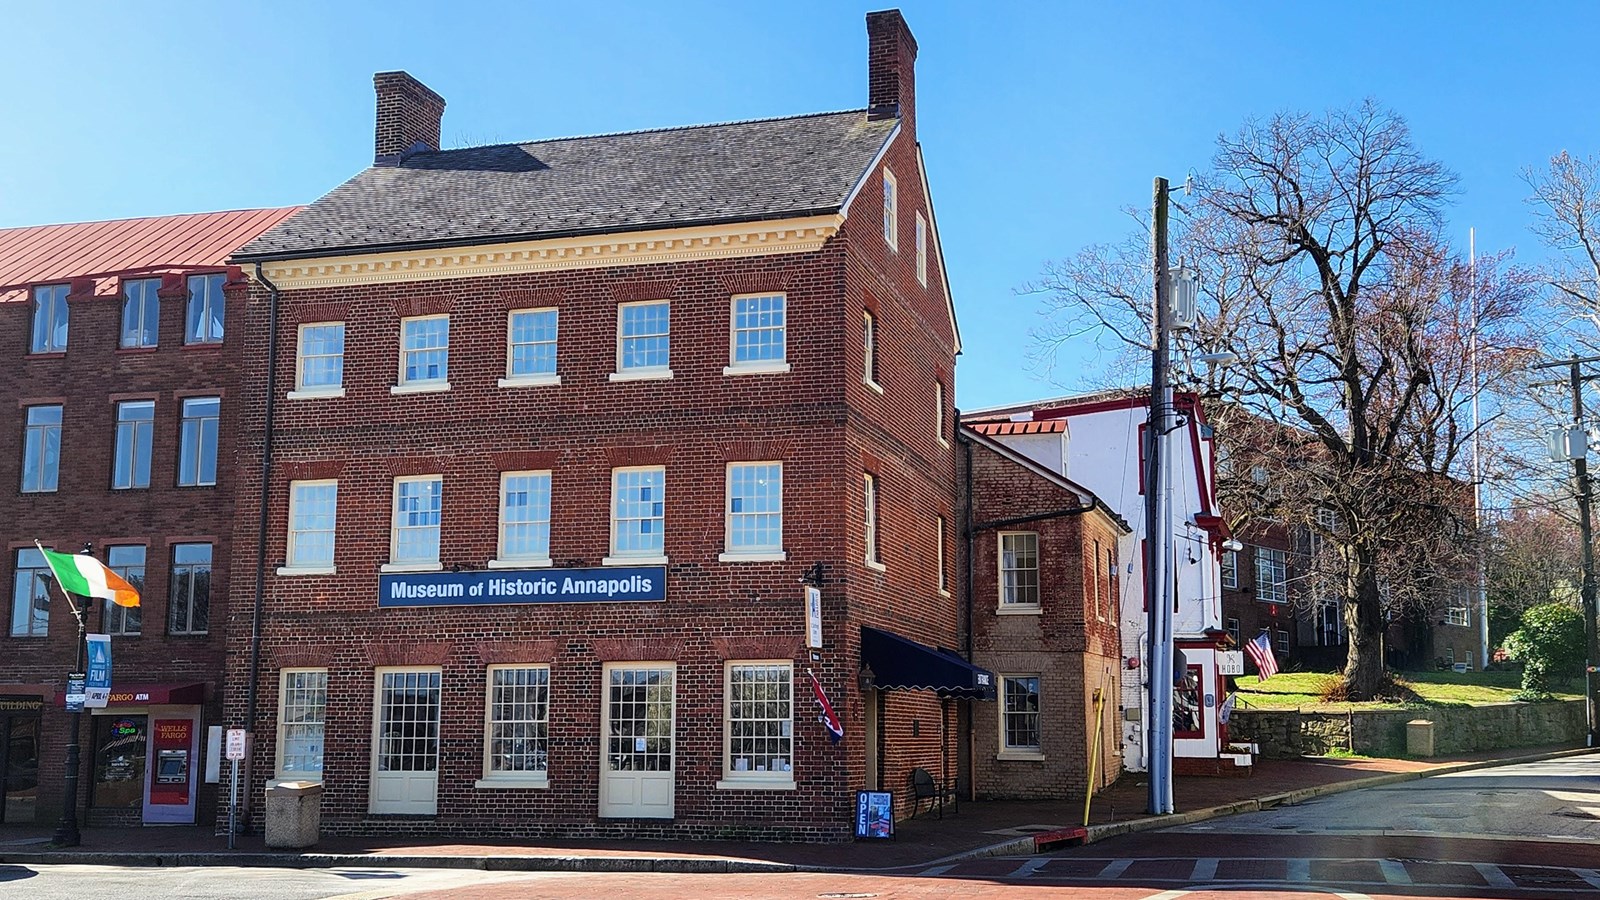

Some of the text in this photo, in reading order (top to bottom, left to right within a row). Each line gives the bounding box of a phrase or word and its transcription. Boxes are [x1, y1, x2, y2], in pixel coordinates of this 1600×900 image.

[391, 575, 652, 599] Museum of Historic Annapolis
[90, 669, 105, 682] FILM
[1222, 665, 1240, 673] HOBO
[119, 727, 136, 735] Spa
[858, 793, 868, 835] OPEN
